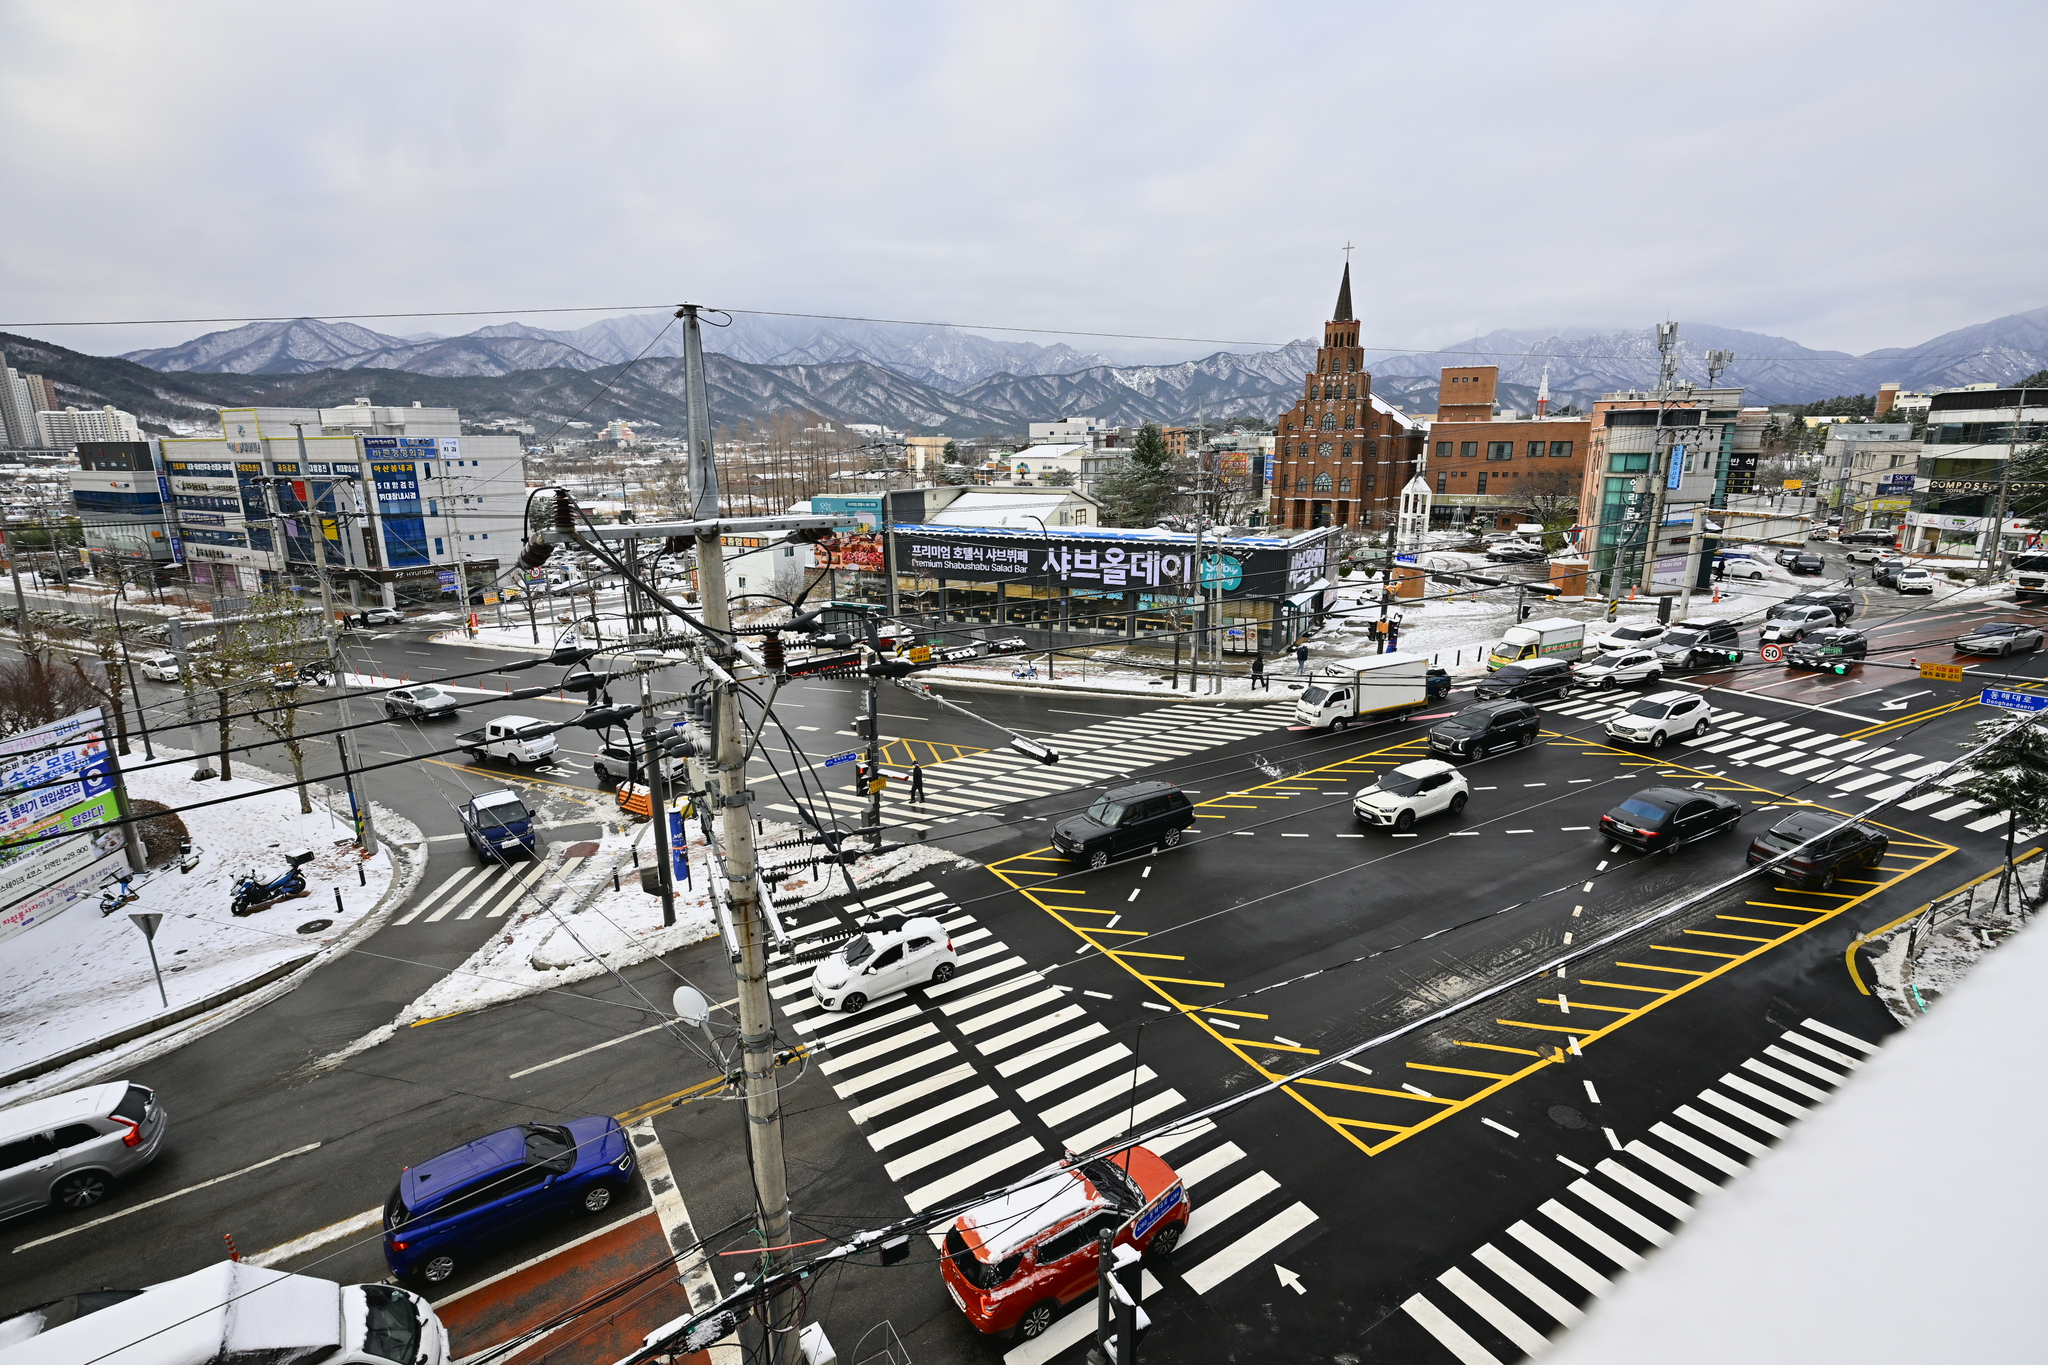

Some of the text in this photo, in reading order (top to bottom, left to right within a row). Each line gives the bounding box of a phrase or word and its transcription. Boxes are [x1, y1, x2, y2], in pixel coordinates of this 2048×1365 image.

[372, 449, 426, 458] 바른정형외과
[374, 464, 413, 472] 아산봄내과
[1730, 457, 1755, 466] 반석
[1931, 481, 1988, 490] COMPOSE
[379, 492, 417, 500] 위대장내시경
[911, 545, 1029, 564] 프리미엄 호텔식 샤브뷔페
[911, 559, 1028, 573] Premium Shabushabu Salad Bar
[1042, 546, 1191, 589] 샤브올데이
[1289, 541, 1327, 590] 샤브올데이
[406, 569, 435, 577] HYUNDAI
[1764, 647, 1777, 658] 50
[1922, 662, 1934, 670] 긴급
[1990, 691, 2032, 703] 동해대로
[1986, 698, 2035, 711] Donghae-daero
[53, 719, 81, 737] 입니다
[22, 748, 59, 765] 속초교육원
[9, 751, 77, 784] 소수 모집
[10, 799, 39, 819] 봄학기
[39, 781, 82, 808] 편입생모집
[7, 816, 28, 829] 국비지원
[70, 804, 106, 828] 잘한다!
[0, 878, 25, 893] 스테이크
[26, 869, 43, 880] 4코스
[44, 859, 62, 871] 지역민
[47, 895, 54, 905] 날
[90, 861, 120, 881] 초대합니다
